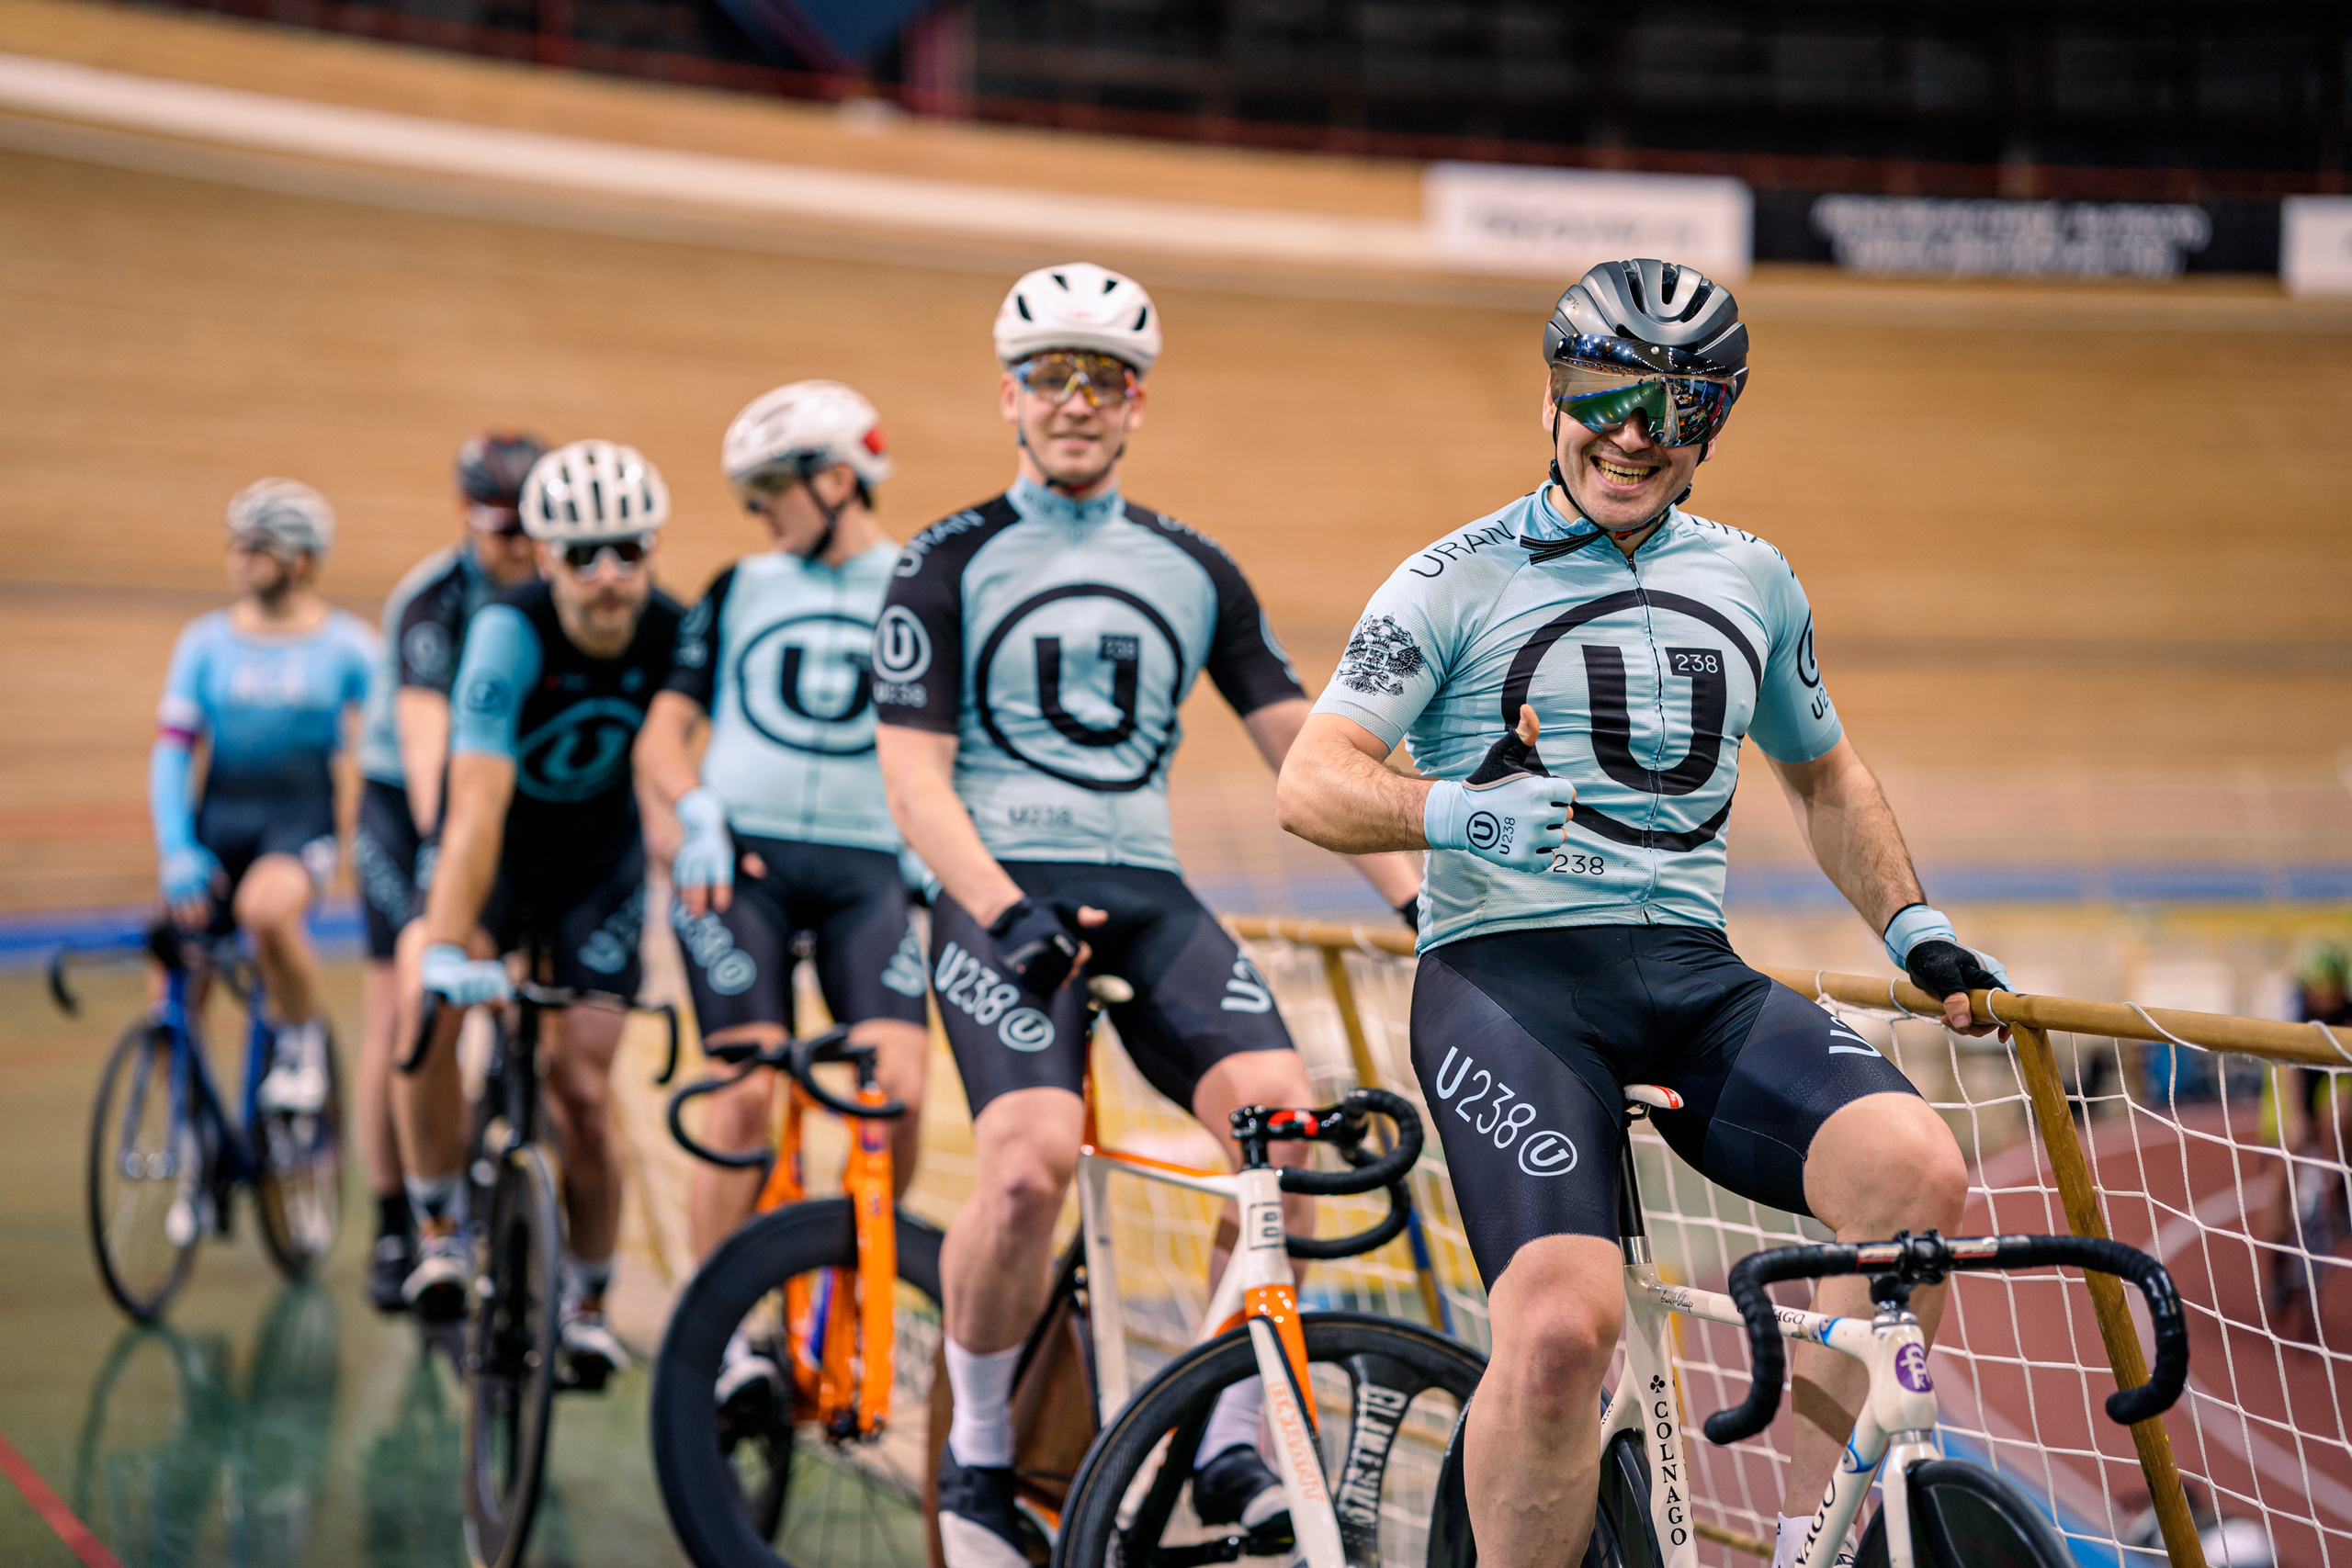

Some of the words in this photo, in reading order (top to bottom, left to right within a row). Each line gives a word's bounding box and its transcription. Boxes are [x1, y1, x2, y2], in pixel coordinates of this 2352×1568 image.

[1408, 520, 1517, 578] URAN
[1675, 653, 1718, 673] 238
[1582, 644, 1727, 795] U
[1499, 817, 1516, 855] U238
[1553, 853, 1604, 875] 238
[934, 941, 1021, 1027] U238
[1435, 1045, 1537, 1149] U238
[1654, 1401, 1687, 1546] COLNAGO
